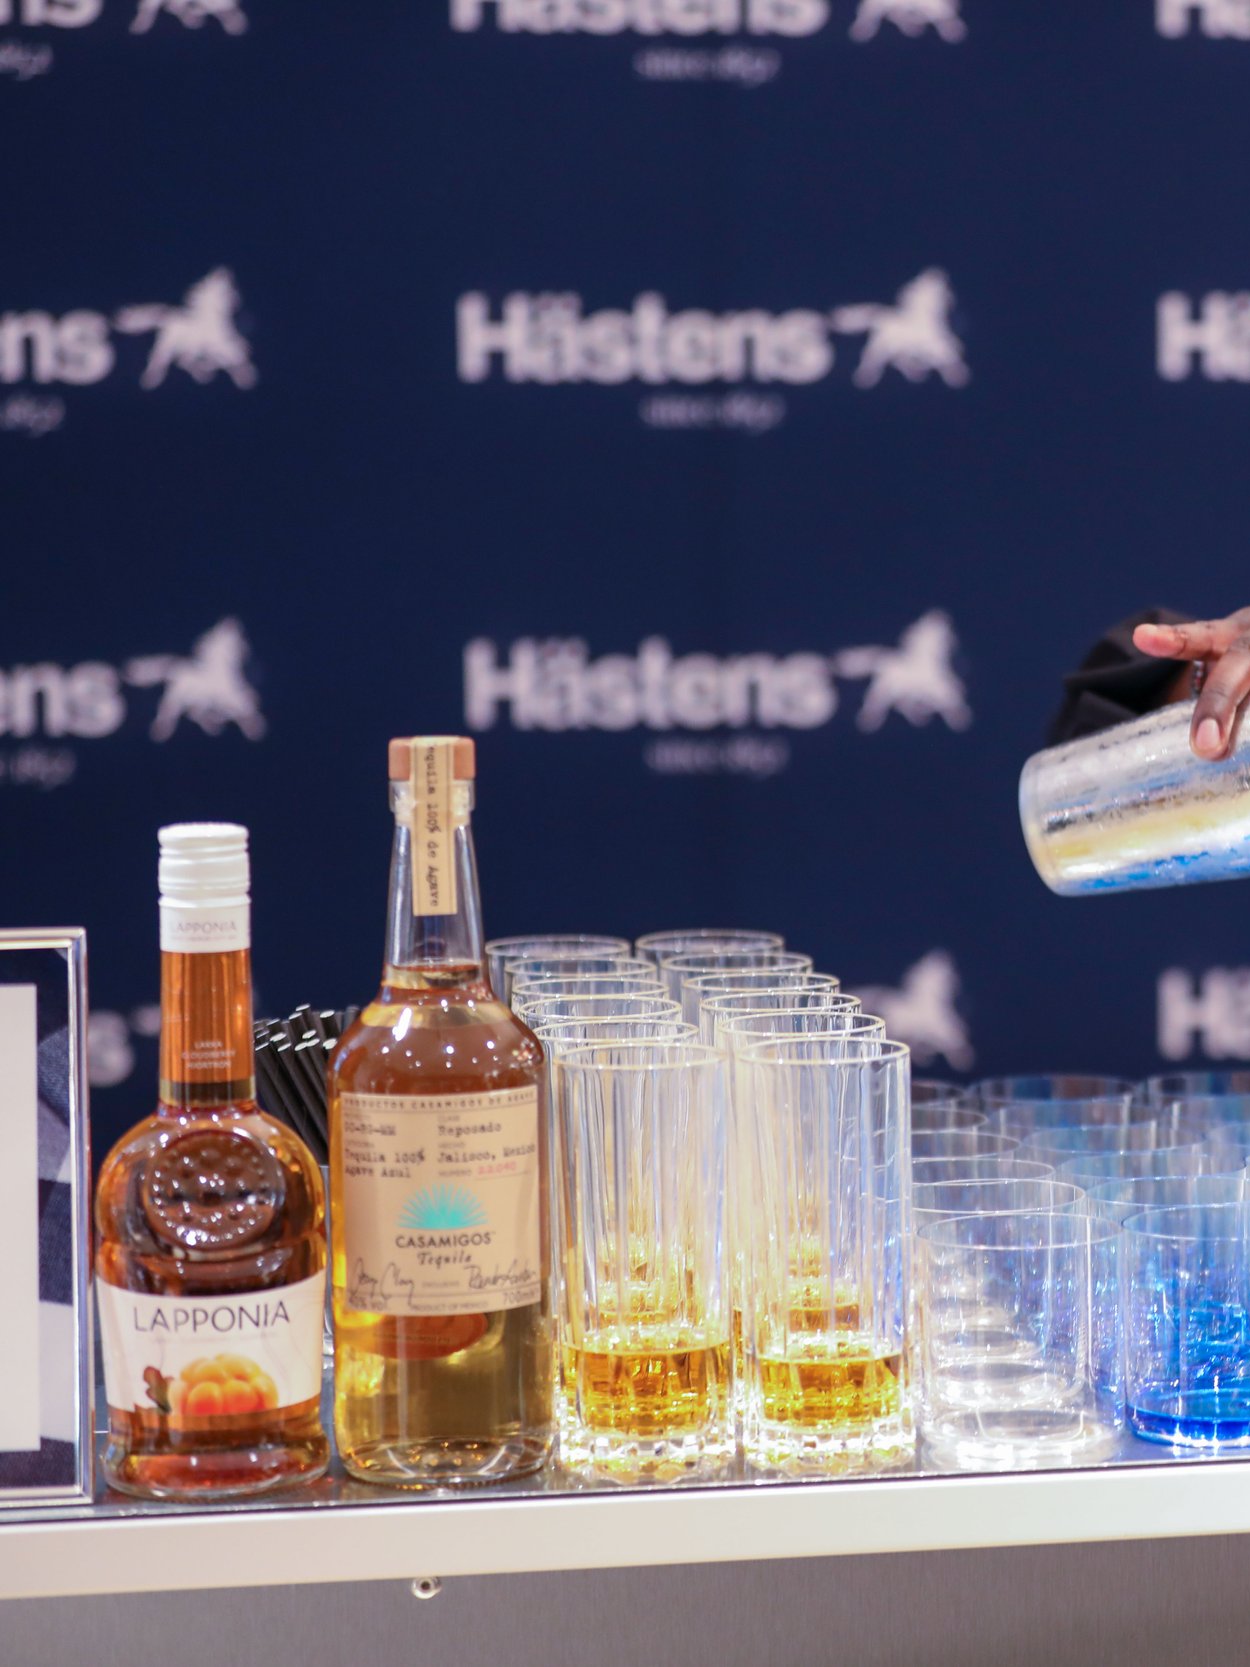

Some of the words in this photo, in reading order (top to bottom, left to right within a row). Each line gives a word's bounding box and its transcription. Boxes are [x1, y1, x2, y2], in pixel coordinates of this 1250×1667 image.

[456, 290, 834, 385] Hästens
[463, 635, 838, 732] Hästens
[437, 1121, 502, 1138] Reposado
[344, 1148, 386, 1163] Tequila
[394, 1147, 425, 1166] 100%
[437, 1150, 497, 1164] Jalisco,
[381, 1164, 412, 1179] Azul
[395, 1231, 491, 1249] CASAMIGOS
[417, 1250, 472, 1270] Tequila
[133, 1299, 291, 1333] LAPPONIA
